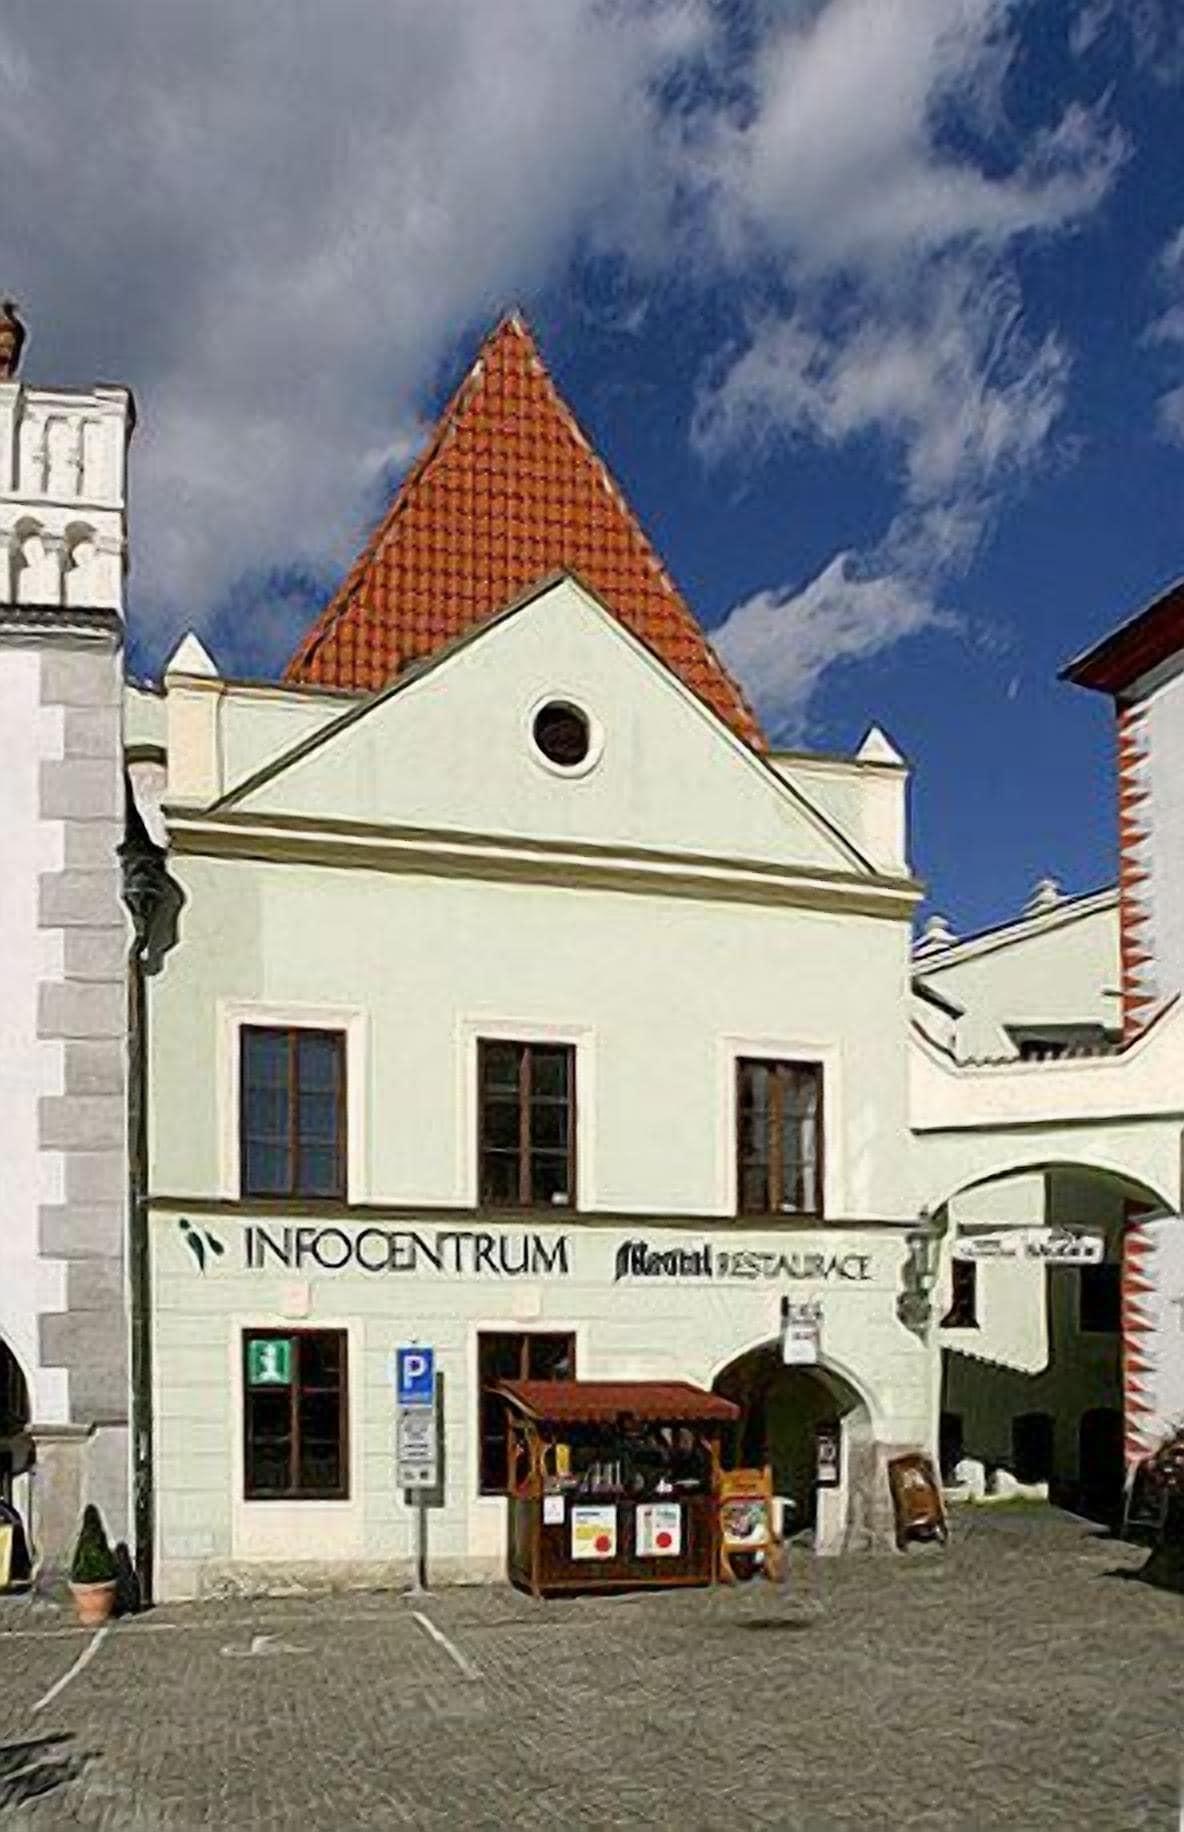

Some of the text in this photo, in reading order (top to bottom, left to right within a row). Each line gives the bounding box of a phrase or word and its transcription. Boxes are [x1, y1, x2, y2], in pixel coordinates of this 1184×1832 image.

[244, 1226, 570, 1275] INFOCENTRUM
[716, 1251, 875, 1281] RESTAURACE
[403, 1356, 426, 1389] P
